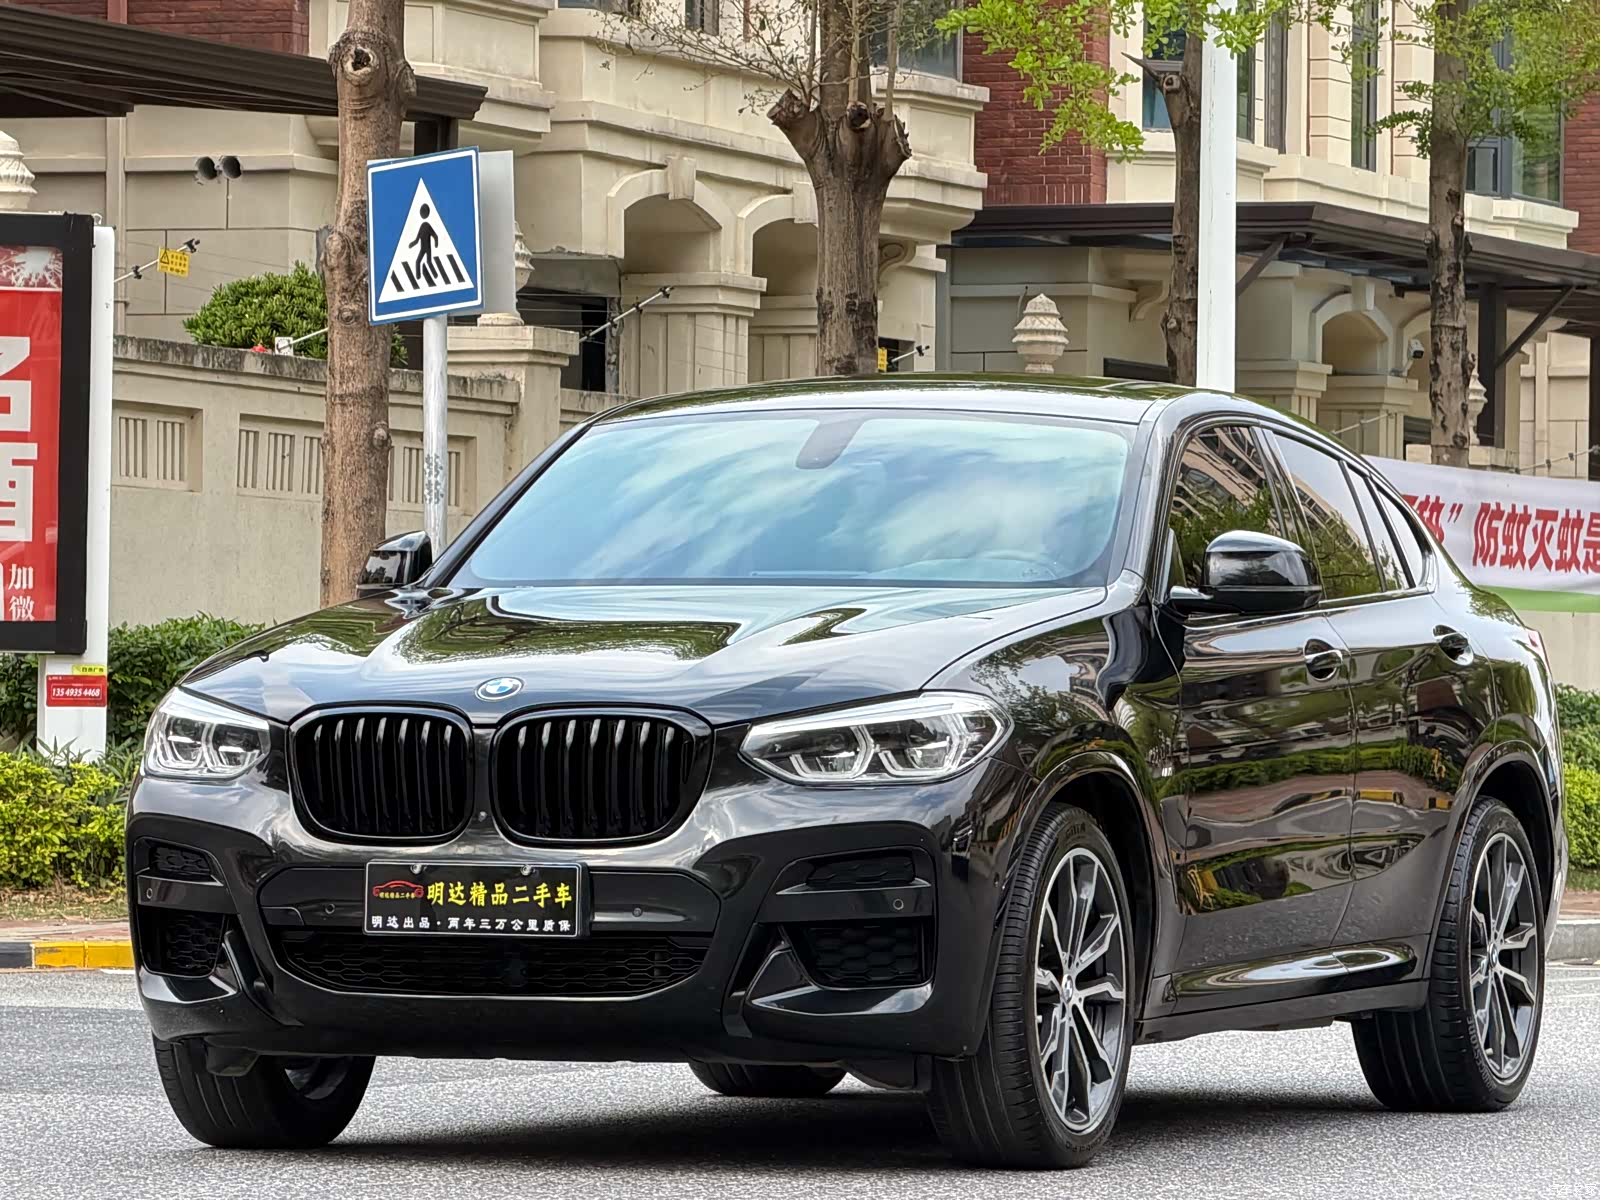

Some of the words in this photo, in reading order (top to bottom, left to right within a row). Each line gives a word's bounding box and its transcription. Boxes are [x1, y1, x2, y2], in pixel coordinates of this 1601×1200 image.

[8, 563, 35, 621] 加微
[52, 687, 65, 697] 135
[427, 881, 573, 909] 明达精品二手车
